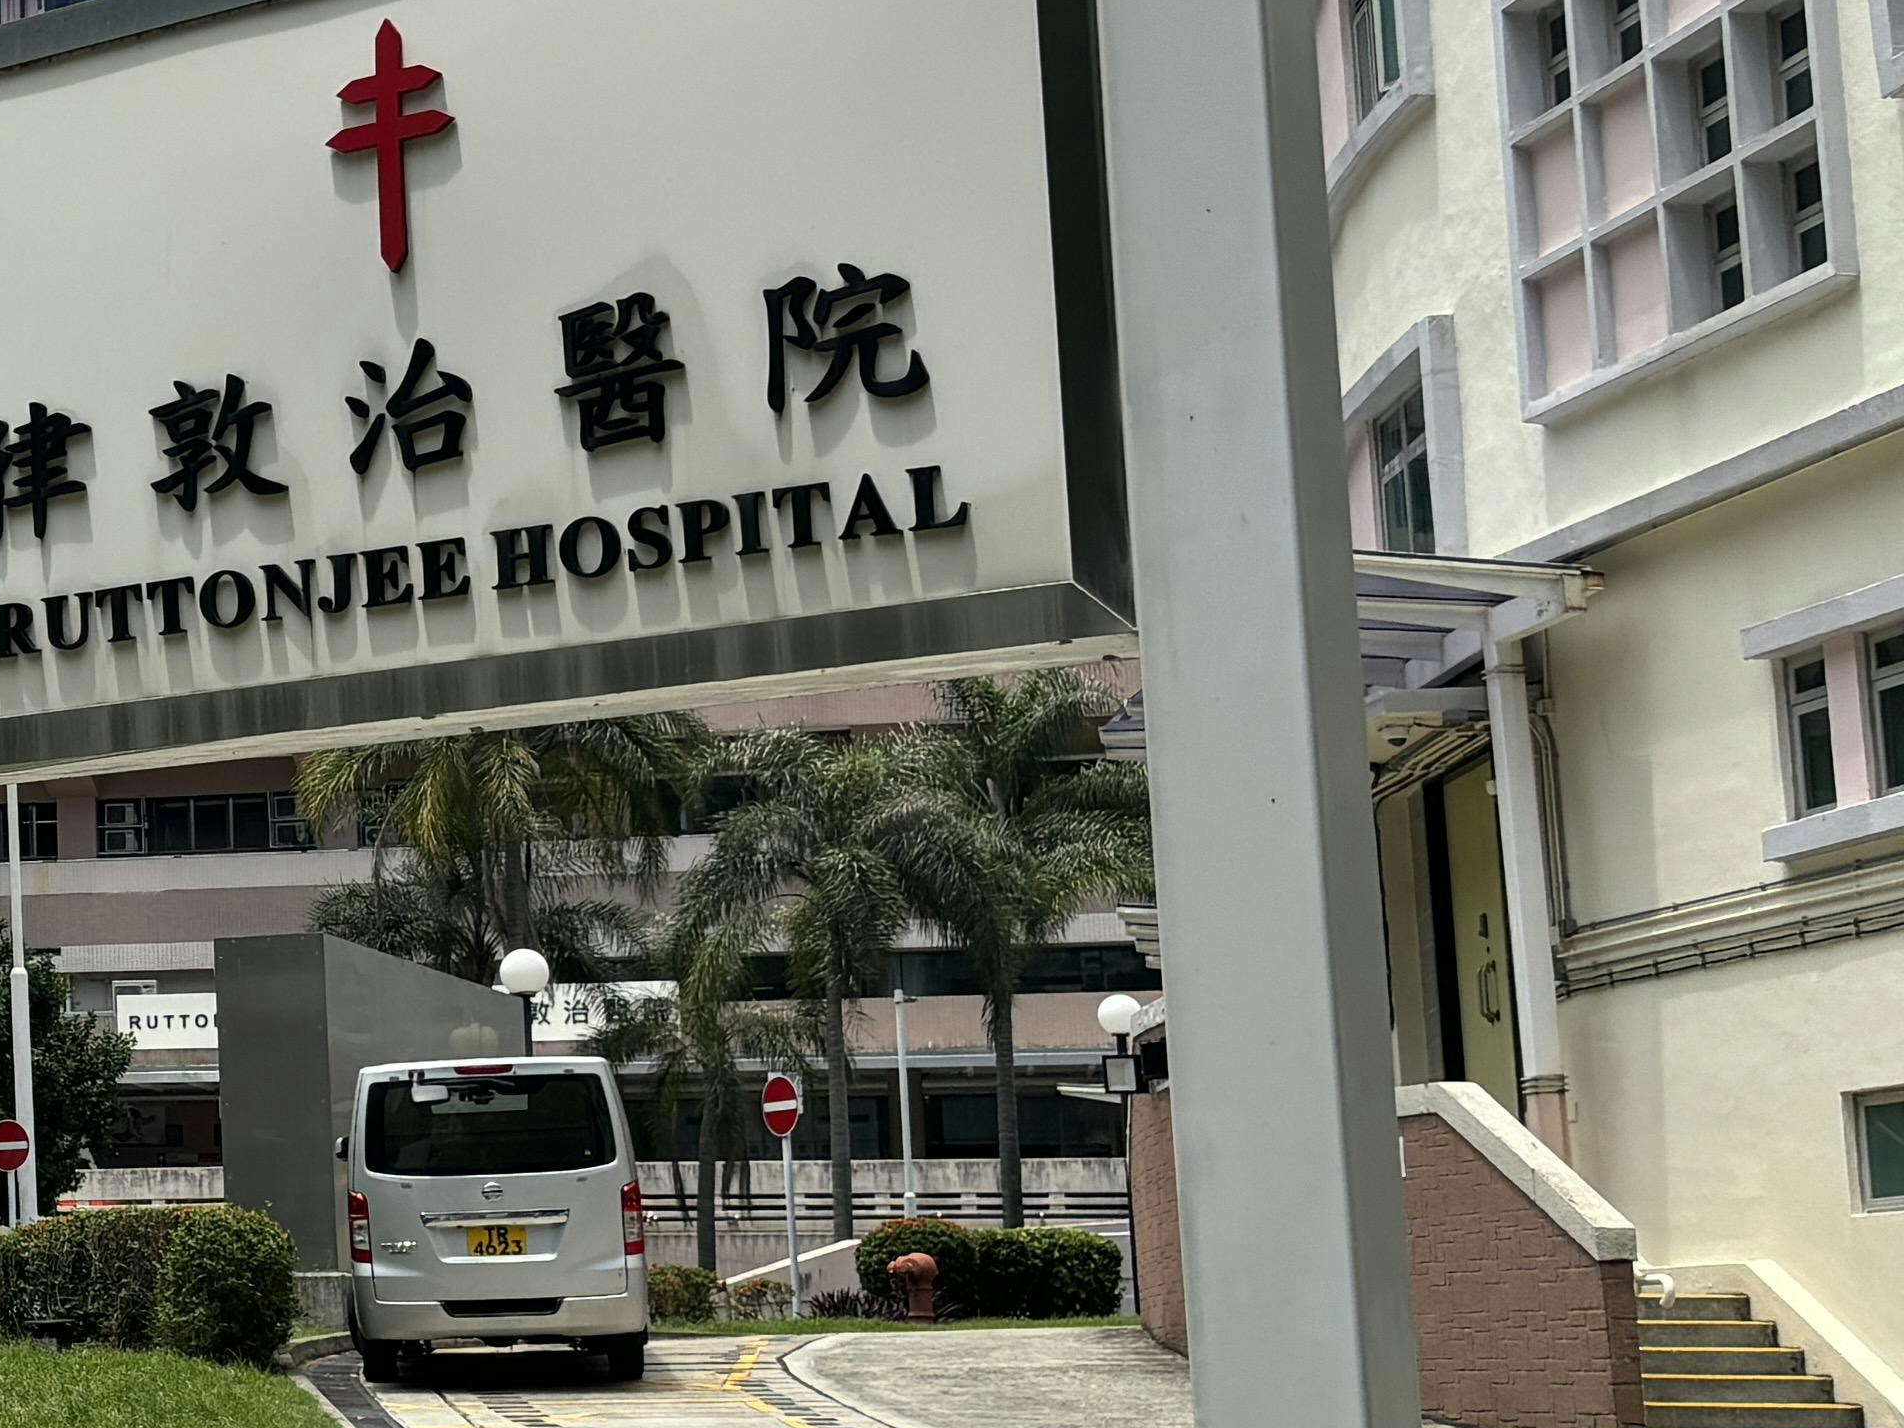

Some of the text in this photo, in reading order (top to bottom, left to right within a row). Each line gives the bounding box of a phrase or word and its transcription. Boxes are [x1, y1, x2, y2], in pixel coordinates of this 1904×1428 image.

[490, 465, 970, 593] HOSPITAL
[128, 1013, 217, 1030] RUTTO
[473, 1240, 523, 1256] 4623
